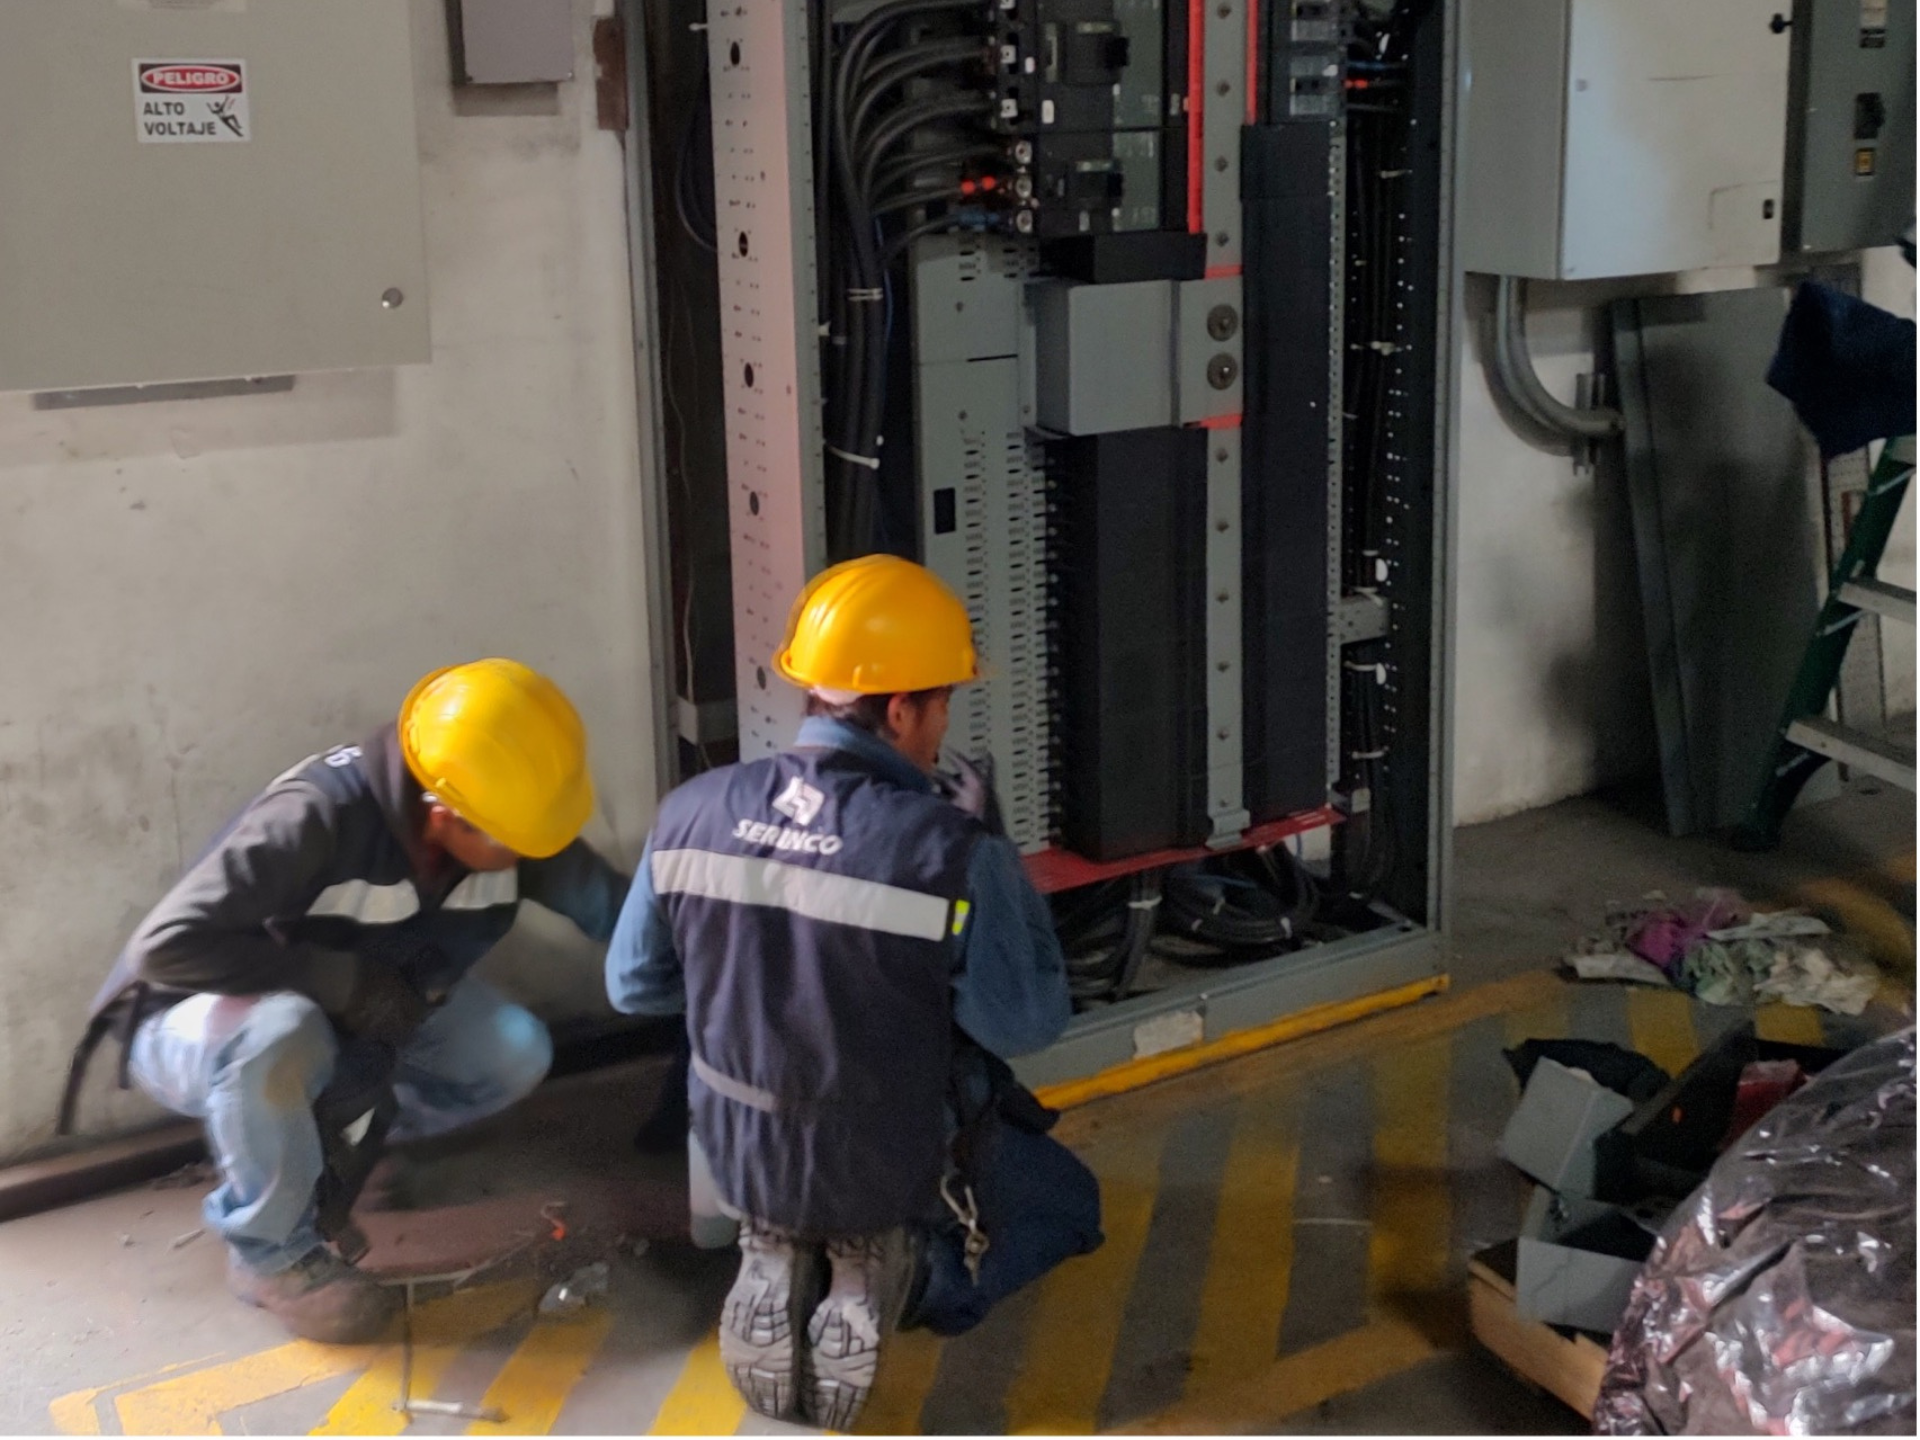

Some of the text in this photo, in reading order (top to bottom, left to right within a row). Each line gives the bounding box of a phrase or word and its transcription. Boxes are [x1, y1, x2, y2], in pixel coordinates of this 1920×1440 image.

[152, 71, 230, 86] PELIGRO
[143, 102, 185, 116] ALTO
[144, 122, 217, 136] VOLTAJE
[732, 818, 843, 855] SERINCO
